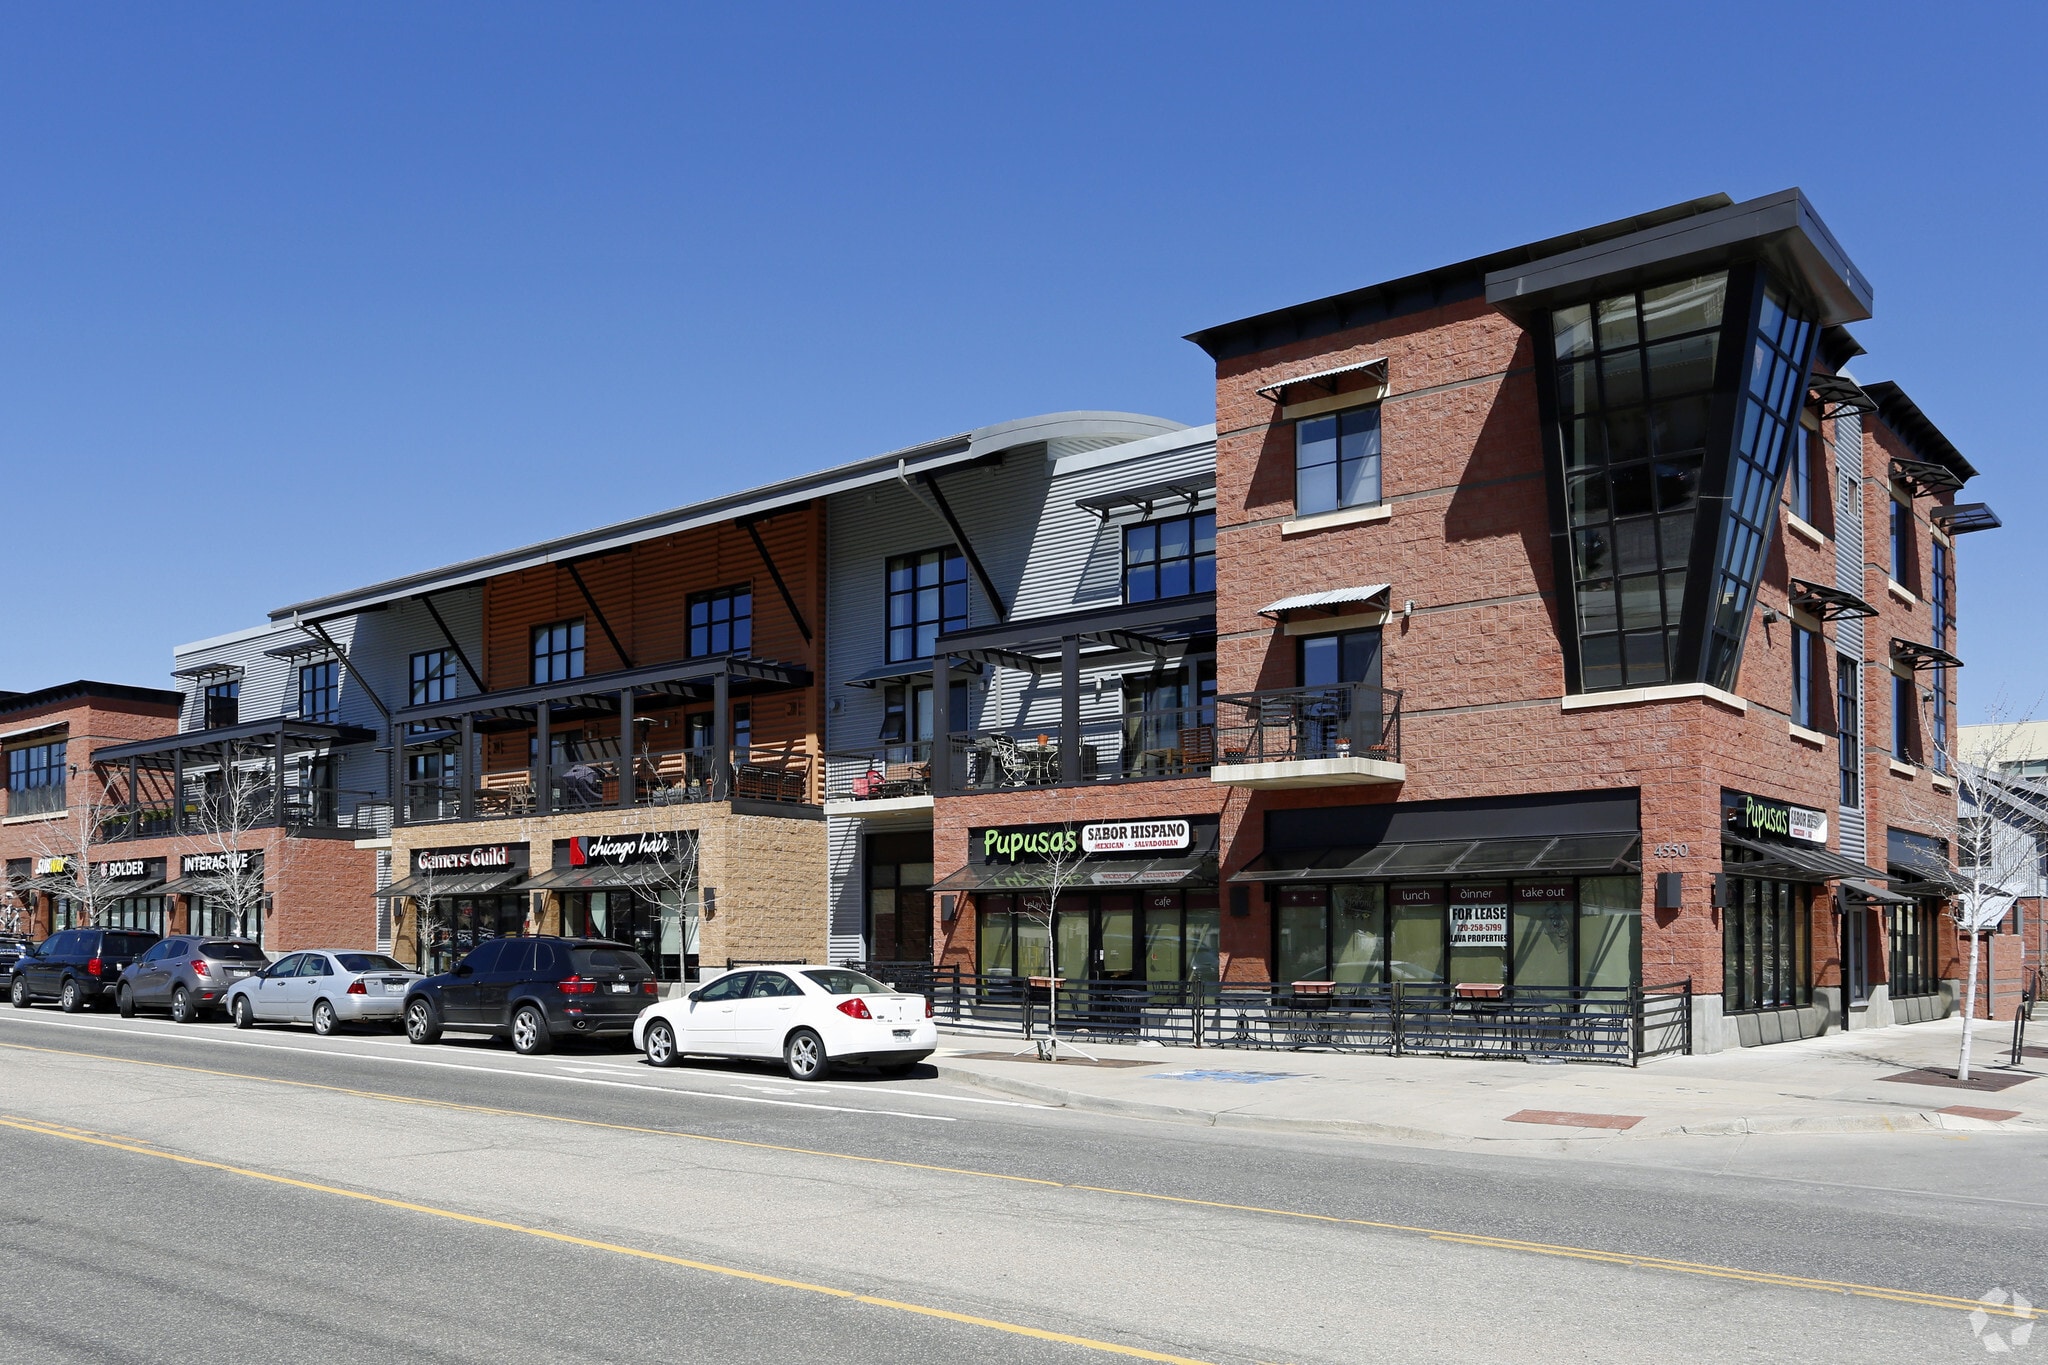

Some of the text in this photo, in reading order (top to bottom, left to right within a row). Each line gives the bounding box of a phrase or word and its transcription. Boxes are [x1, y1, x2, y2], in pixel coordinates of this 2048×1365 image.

[1745, 796, 1788, 839] Pupusas
[1087, 823, 1185, 841] SABOR HISPANO
[588, 832, 669, 862] chicago hair
[984, 829, 1078, 861] Pupusas
[1134, 839, 1179, 848] SALVADORIAN
[1653, 843, 1690, 858] 4550
[418, 846, 509, 870] Gamers Guild
[109, 861, 144, 876] BOLDER
[1402, 890, 1430, 901] lunch
[1460, 889, 1493, 899] dinner
[1522, 887, 1565, 898] take out
[1154, 896, 1171, 907] cafe
[1453, 907, 1506, 920] FOR LEASE
[1457, 923, 1502, 932] 720-258-5799
[1450, 934, 1508, 943] LAVA PROPERTIES
